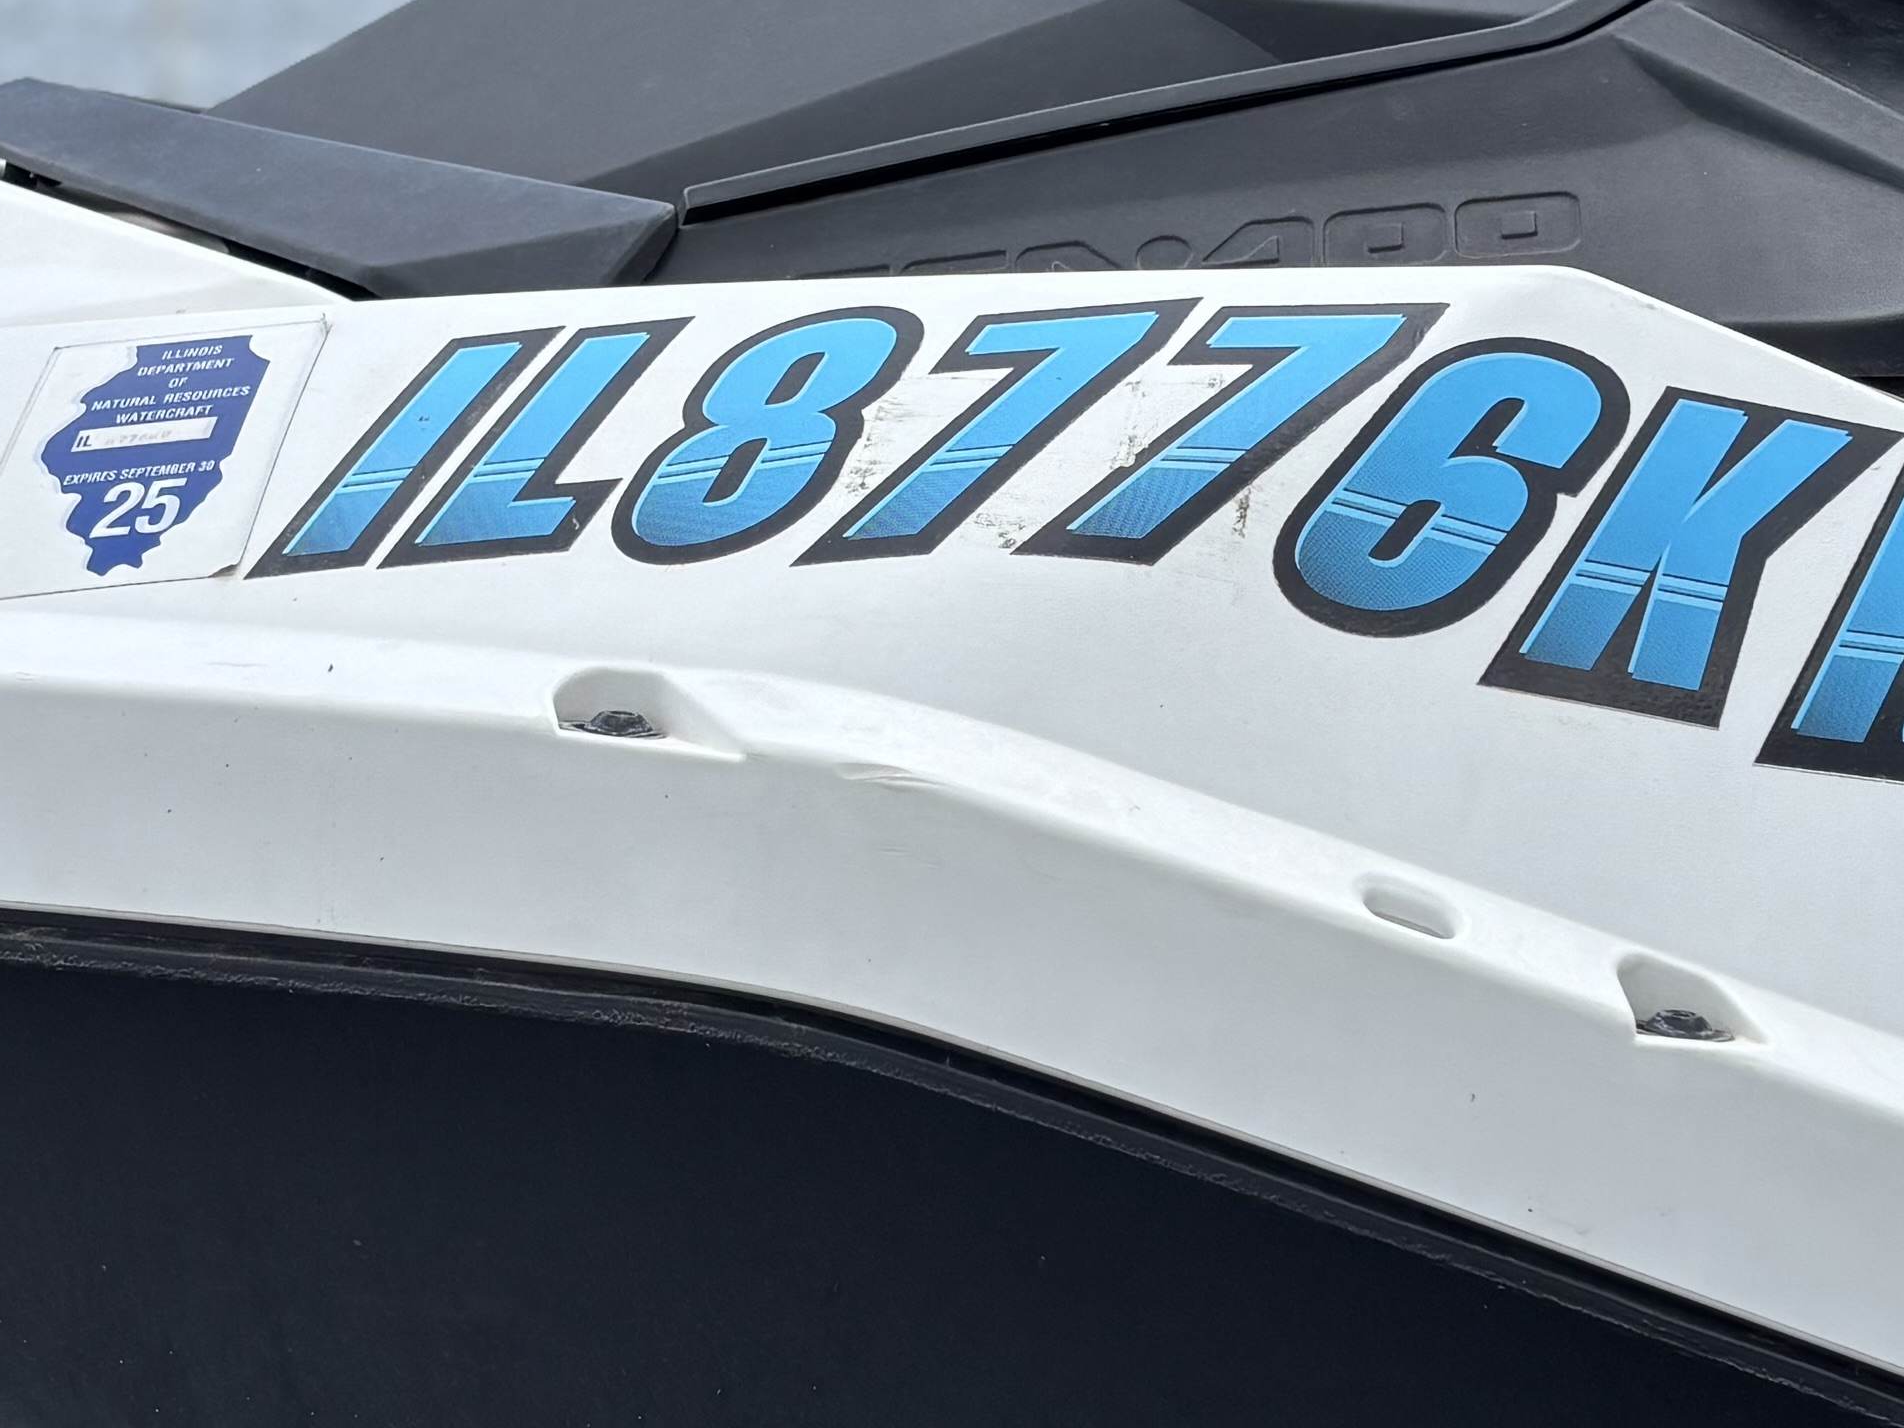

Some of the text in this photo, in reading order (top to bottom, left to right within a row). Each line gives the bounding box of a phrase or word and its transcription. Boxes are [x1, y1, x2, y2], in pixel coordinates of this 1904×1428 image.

[162, 345, 223, 360] ILLINOIS
[137, 358, 235, 377] DEPARTMENT
[168, 377, 188, 389] OF
[91, 386, 251, 412] NATURAL RESOURCES
[116, 404, 213, 424] WATERCRAFT
[63, 460, 216, 486] EXPIRES SEPTEMBER 30
[88, 477, 188, 539] 25
